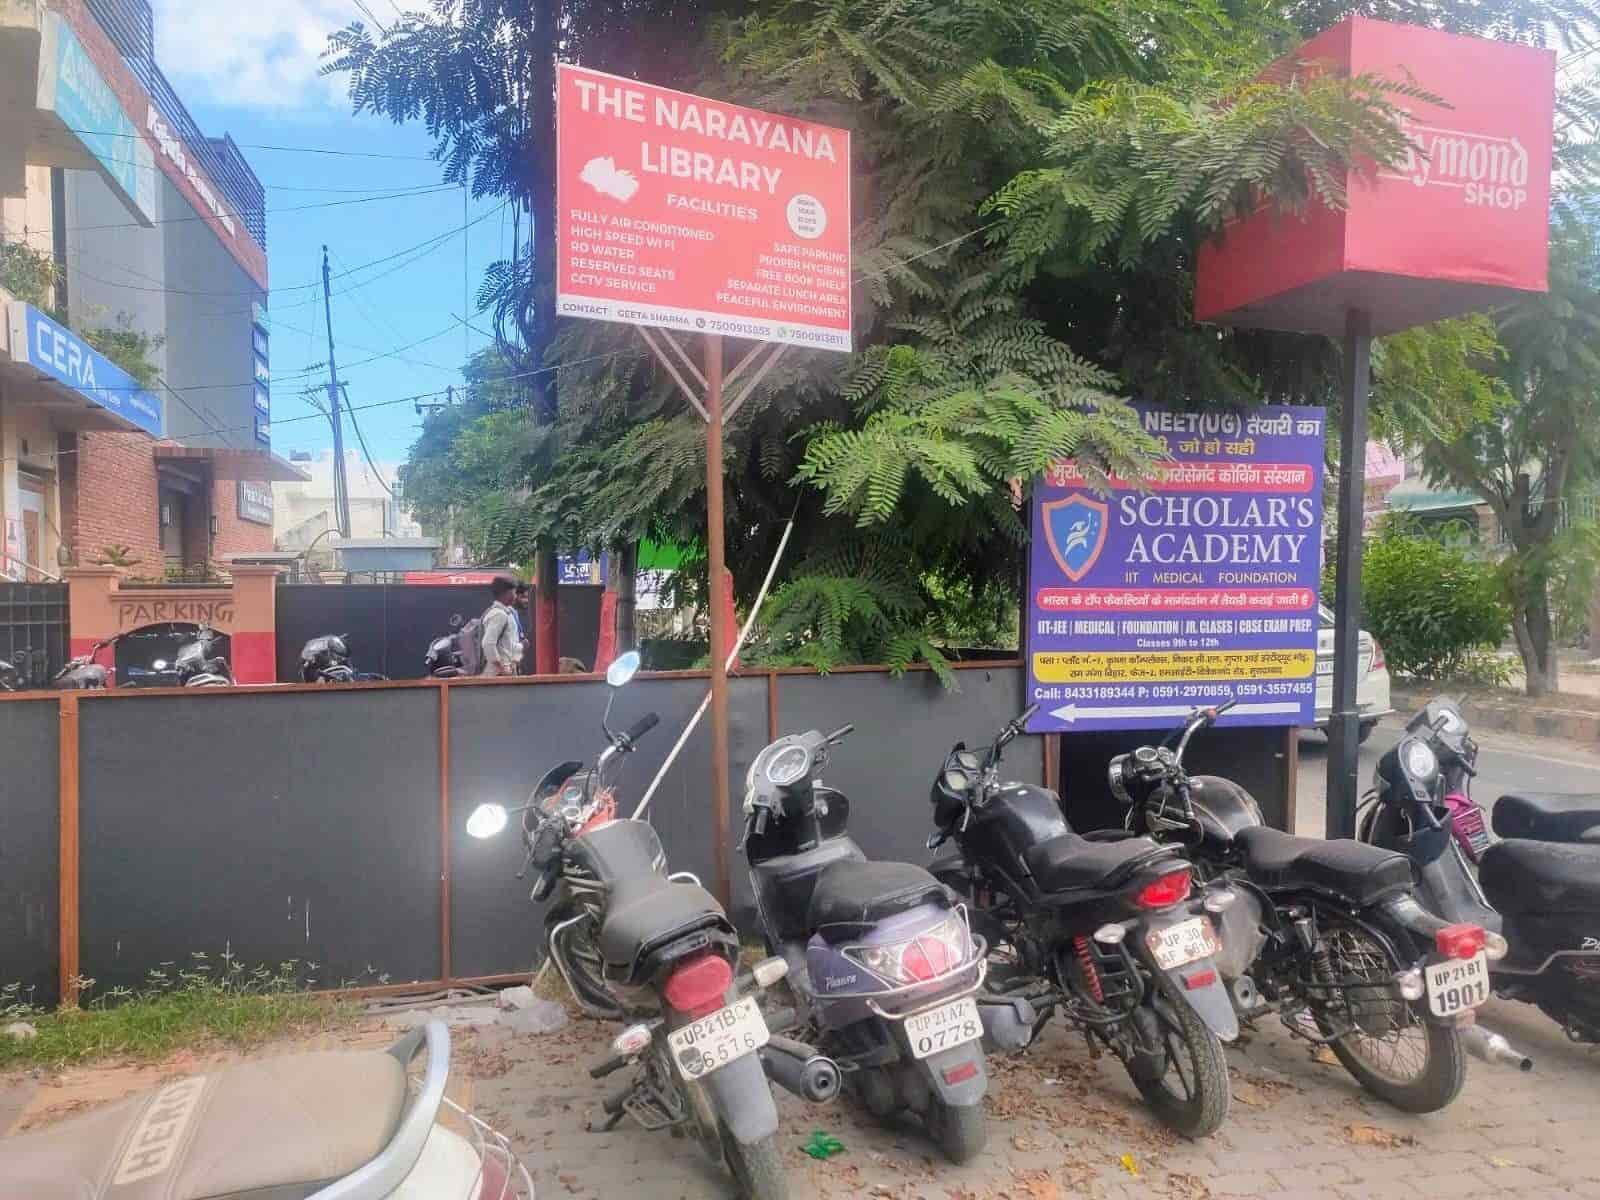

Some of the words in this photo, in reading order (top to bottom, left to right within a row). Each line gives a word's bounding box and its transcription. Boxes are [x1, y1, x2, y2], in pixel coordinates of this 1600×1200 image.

[573, 79, 645, 123] THE
[655, 98, 836, 163] NARAYANA
[641, 142, 782, 194] LIBRARY
[667, 194, 759, 221] FACILITIES
[1464, 183, 1527, 210] SHOP
[571, 209, 607, 225] FULLY
[611, 217, 632, 229] AIR
[633, 220, 714, 241] CONDITIONED
[571, 225, 603, 239] HIGH
[605, 231, 644, 246] SPEED
[571, 240, 590, 252] RO
[592, 244, 634, 259] WATER
[774, 242, 800, 255] SAFE
[802, 247, 847, 263] PARKING
[571, 256, 635, 275] RESERVED
[639, 265, 675, 281] SEATS
[759, 253, 800, 269] PROPER
[802, 262, 847, 277] HYGIENE
[571, 273, 603, 286] CCTV
[606, 278, 656, 293] SERVICE
[727, 279, 781, 297] SEPARATE
[783, 287, 817, 300] LUNCH
[819, 293, 847, 305] AREA
[756, 269, 783, 280] FREE
[785, 273, 813, 286] BOOK
[817, 277, 847, 290] SHELF
[617, 309, 648, 320] GEETA
[649, 313, 690, 325] SHARMA
[716, 292, 769, 309] PEACEFUL
[773, 300, 847, 319] ENVIRONMENT
[36, 319, 97, 393] CERA
[1144, 411, 1242, 438] NEET(UG)
[1296, 419, 1320, 436] का
[1177, 439, 1200, 453] जो
[1203, 439, 1221, 455] हो
[1224, 438, 1256, 455] सही
[1119, 495, 1314, 528] SCHOLAR'S
[1125, 533, 1307, 564] ACADEMY
[1124, 572, 1138, 584] IIT
[1153, 572, 1205, 584] MEDICAL
[1218, 571, 1297, 584] FOUNDATION
[119, 600, 235, 628] PARKING
[1037, 620, 1068, 635] IIT-JEE
[1074, 620, 1116, 634] MEDICAL
[1122, 620, 1180, 634] FOUNDATION
[1200, 619, 1233, 633] CLASES
[1263, 619, 1288, 632] EXAM
[1289, 619, 1313, 632] PREP.
[1136, 638, 1170, 648] Classes
[1172, 637, 1187, 647] 9th
[1188, 639, 1198, 647] to
[1200, 637, 1220, 647] 12th
[1034, 687, 1061, 700] Call:
[1064, 686, 1135, 699] 8433189344
[1236, 682, 1313, 696] 0591-3557455
[1436, 980, 1484, 1013] 1901
[918, 1020, 977, 1053] 0778
